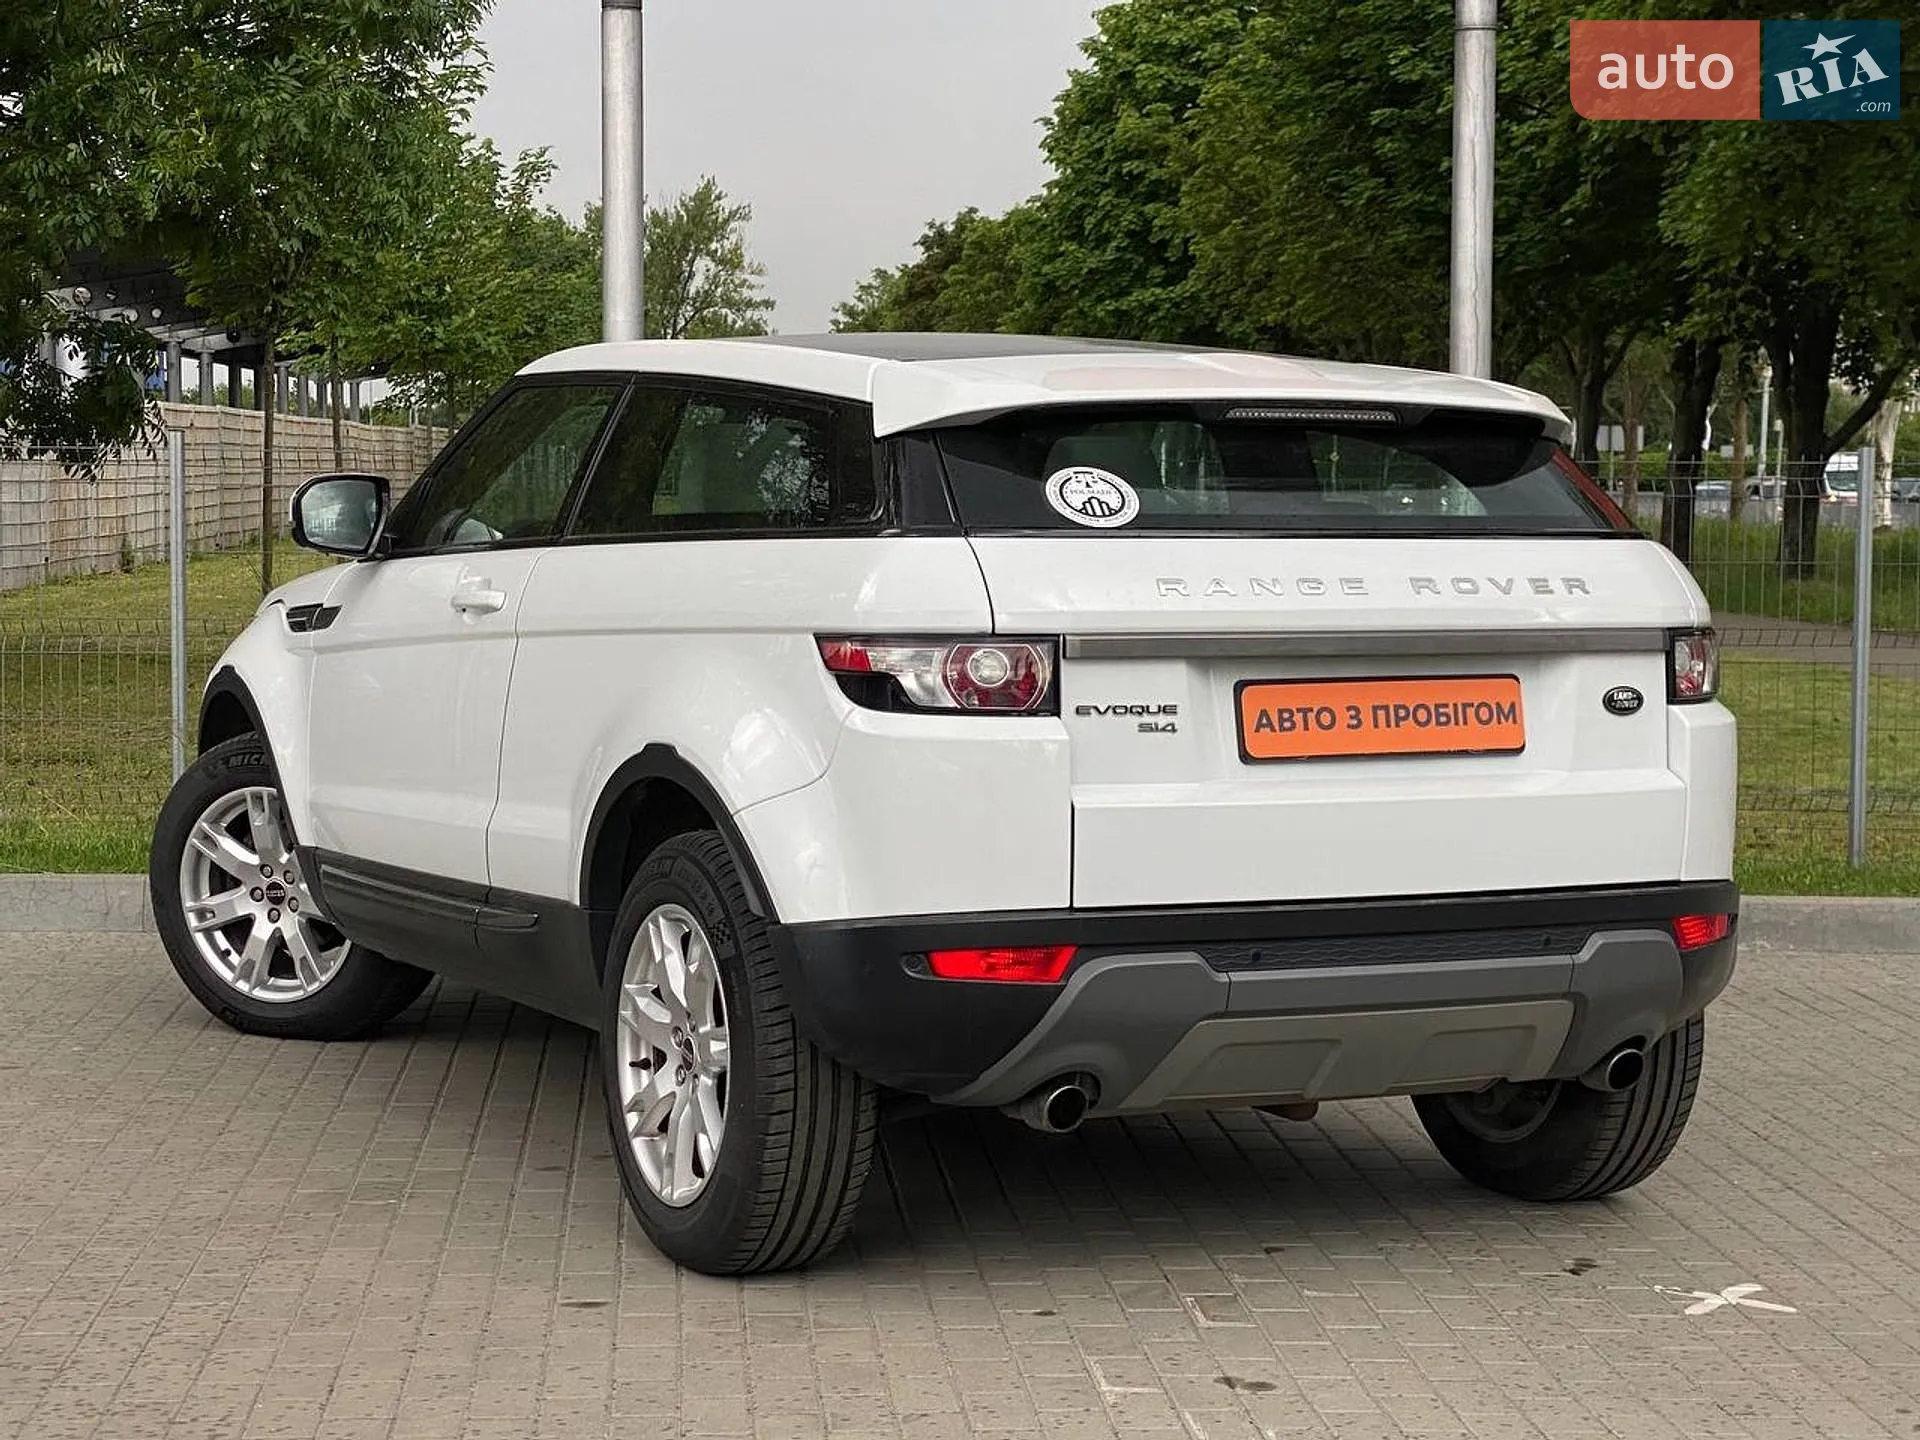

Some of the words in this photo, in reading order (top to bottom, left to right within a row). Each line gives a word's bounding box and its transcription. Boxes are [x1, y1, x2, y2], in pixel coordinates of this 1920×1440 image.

[1156, 577, 1369, 597] RANGE
[1408, 576, 1591, 596] ROVER
[1075, 704, 1178, 716] EVOQUE
[1254, 706, 1337, 734] АВТО
[1371, 701, 1518, 729] ПРОБІГОМ
